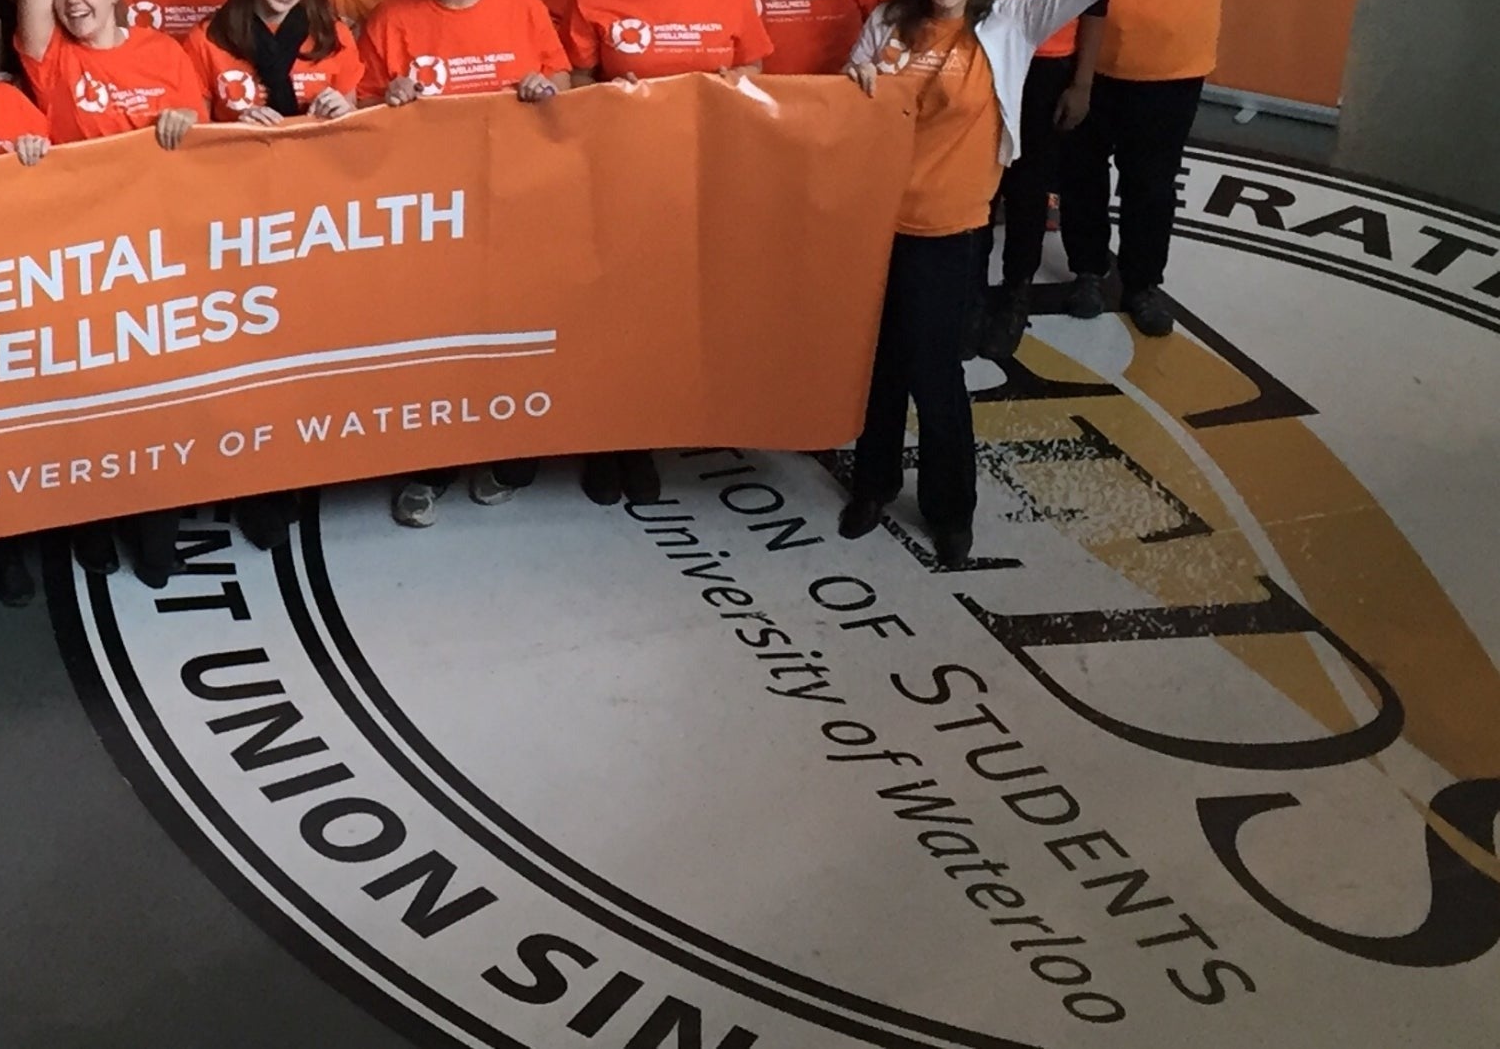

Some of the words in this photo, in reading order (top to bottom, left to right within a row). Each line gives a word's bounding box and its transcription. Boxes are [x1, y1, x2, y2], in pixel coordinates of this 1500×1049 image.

[210, 190, 465, 271] HEALTH
[219, 425, 275, 457] OF
[296, 391, 553, 444] WATERLOO
[180, 647, 500, 940] UNION
[623, 498, 847, 705] University
[820, 720, 924, 767] of
[875, 778, 1127, 1024] Waterloo
[808, 575, 917, 639] OF
[889, 663, 1257, 1006] STUDENTS
